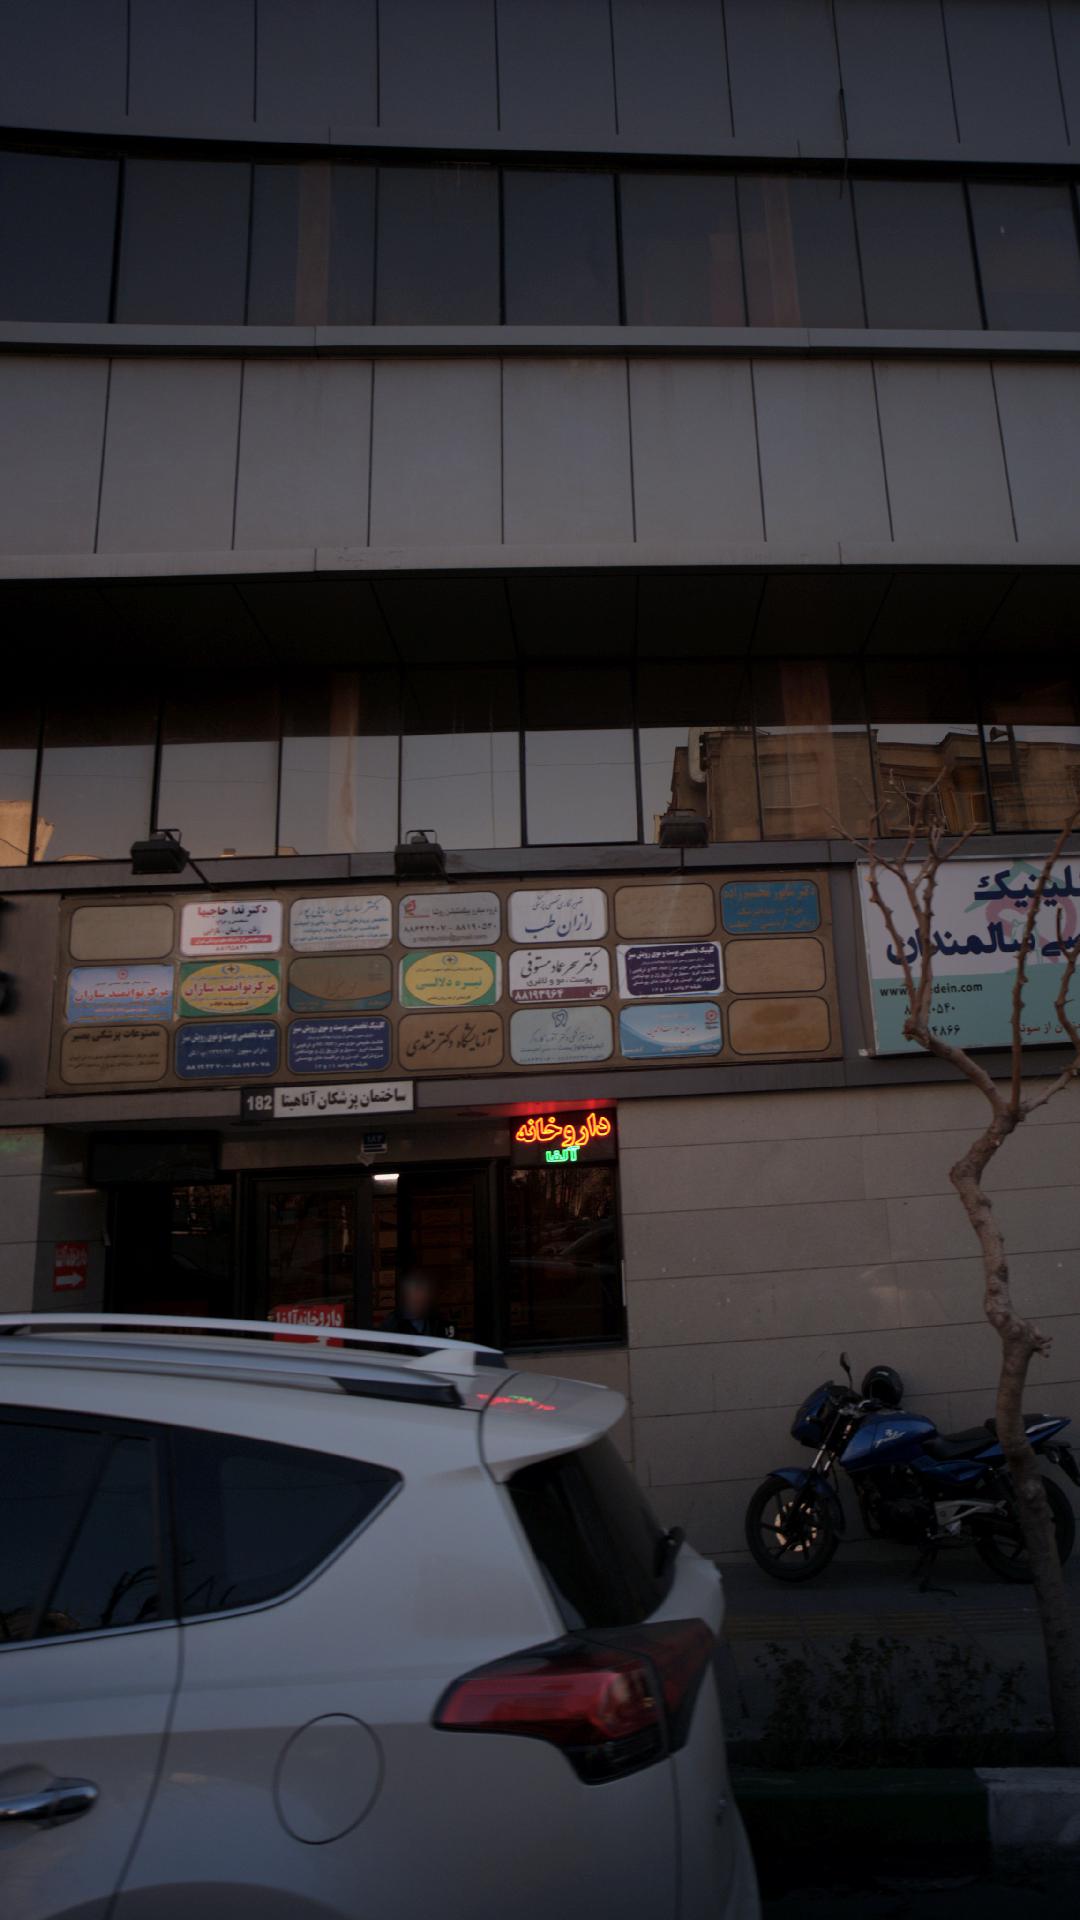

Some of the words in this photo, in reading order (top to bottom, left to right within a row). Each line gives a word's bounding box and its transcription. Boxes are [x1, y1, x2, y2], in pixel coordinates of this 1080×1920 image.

[974, 865, 1080, 907] لینیک
[231, 904, 245, 915] ندا
[246, 904, 268, 917] دکتر
[524, 913, 556, 939] طب
[557, 912, 592, 937] رازان
[519, 951, 551, 978] مستوفی
[551, 959, 566, 973] عماد
[561, 959, 580, 976] سحر
[576, 949, 602, 975] دکتر
[145, 987, 169, 999] مرکز
[252, 980, 276, 994] مرکز
[92, 1030, 121, 1042] پزشکی
[123, 1029, 159, 1041] مصنوعات
[432, 1024, 458, 1053] دکتر
[456, 1022, 498, 1051] آزمایشگاه
[247, 1095, 273, 1111] 182
[281, 1090, 316, 1110] آناهیتا
[317, 1091, 358, 1110] پزشکان
[359, 1088, 406, 1107] ساختمان
[515, 1112, 611, 1147] داروخانه
[545, 1145, 581, 1162] آلفا
[297, 1308, 343, 1327] داروخانه
